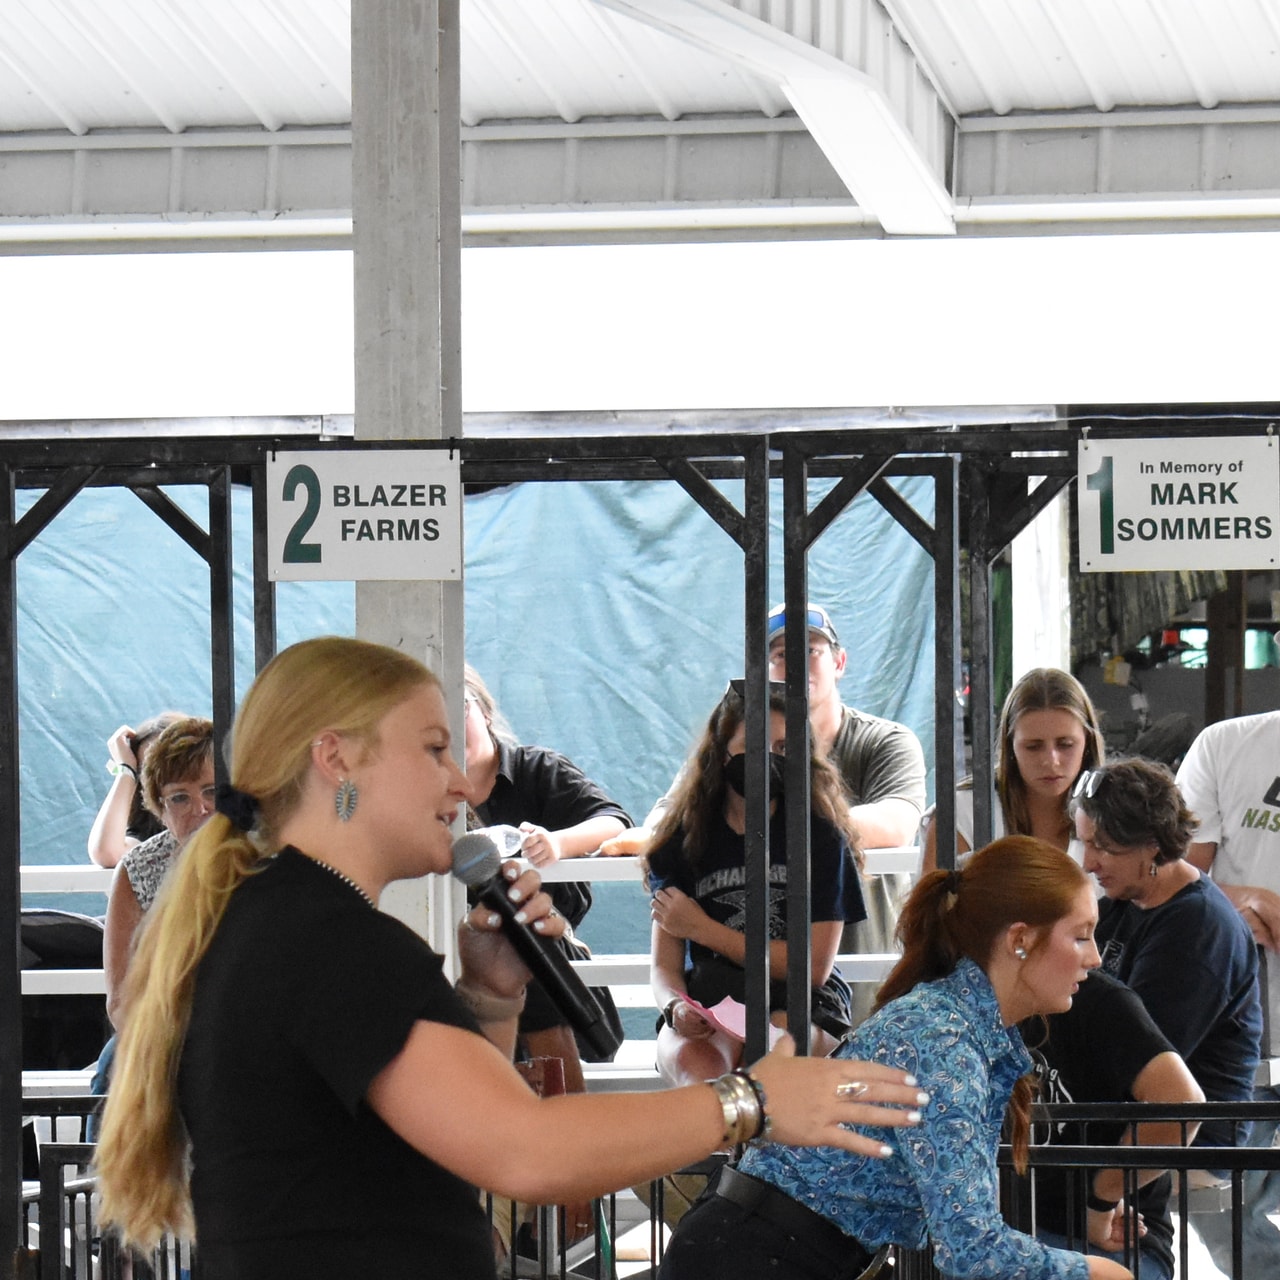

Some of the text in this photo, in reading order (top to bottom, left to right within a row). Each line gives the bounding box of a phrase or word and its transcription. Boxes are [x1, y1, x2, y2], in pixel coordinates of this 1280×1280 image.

[1140, 460, 1243, 476] In Memory of
[333, 484, 447, 507] BLAZER
[1087, 456, 1114, 554] 1
[1151, 482, 1239, 505] MARK
[282, 464, 321, 563] 2
[341, 519, 440, 541] FARMS
[1117, 516, 1272, 541] SOMMERS
